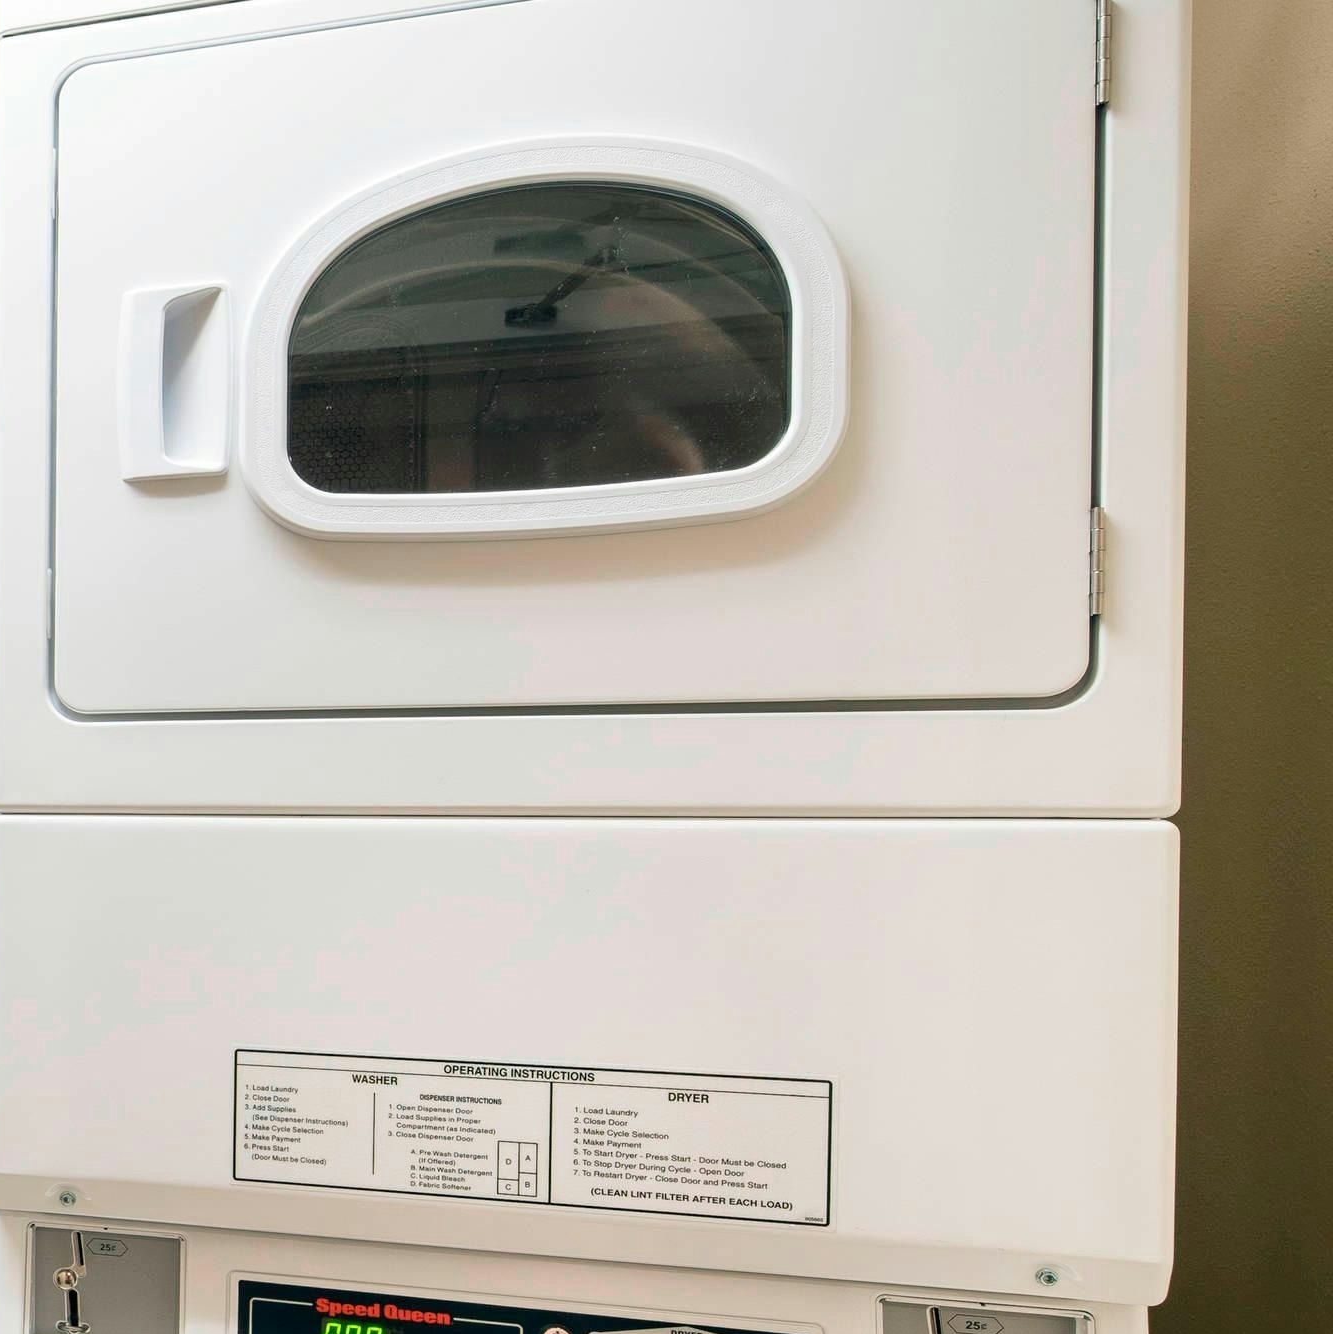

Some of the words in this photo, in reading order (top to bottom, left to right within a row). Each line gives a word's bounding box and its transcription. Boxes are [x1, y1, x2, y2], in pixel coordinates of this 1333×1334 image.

[352, 1074, 398, 1087] WASHER
[444, 1065, 507, 1078] OPERATING
[511, 1068, 595, 1082] INSTRUCTIONS
[420, 1094, 455, 1102] DISPENSER
[456, 1096, 502, 1105] INSTRUCTIONS
[668, 1092, 709, 1103] DRYER
[606, 1108, 638, 1118] Laundry
[607, 1129, 629, 1137] Cycle
[632, 1131, 669, 1139] Selection
[607, 1140, 642, 1149] Payment
[616, 1151, 637, 1159] Dryer
[646, 1153, 669, 1161] Press
[721, 1158, 741, 1166] Must
[757, 1161, 786, 1169] Closed
[594, 1160, 612, 1169] Stop
[615, 1162, 636, 1170] Dryer
[639, 1163, 666, 1173] During
[668, 1165, 691, 1174] Cycle
[699, 1168, 721, 1176] Open
[725, 1169, 744, 1177] Door
[594, 1171, 623, 1179] Restart
[625, 1173, 647, 1181] Dryer
[655, 1175, 678, 1183] Close
[721, 1180, 745, 1188] Press
[748, 1181, 768, 1189] Start
[591, 1188, 628, 1197] (CLEAN
[631, 1191, 653, 1199] LINT
[656, 1193, 689, 1201] FILTER
[693, 1196, 725, 1205] AFTER
[729, 1198, 757, 1207] EACH
[761, 1200, 793, 1211] LOAD)
[316, 1298, 380, 1318] Speed
[384, 1305, 452, 1326] Queen
